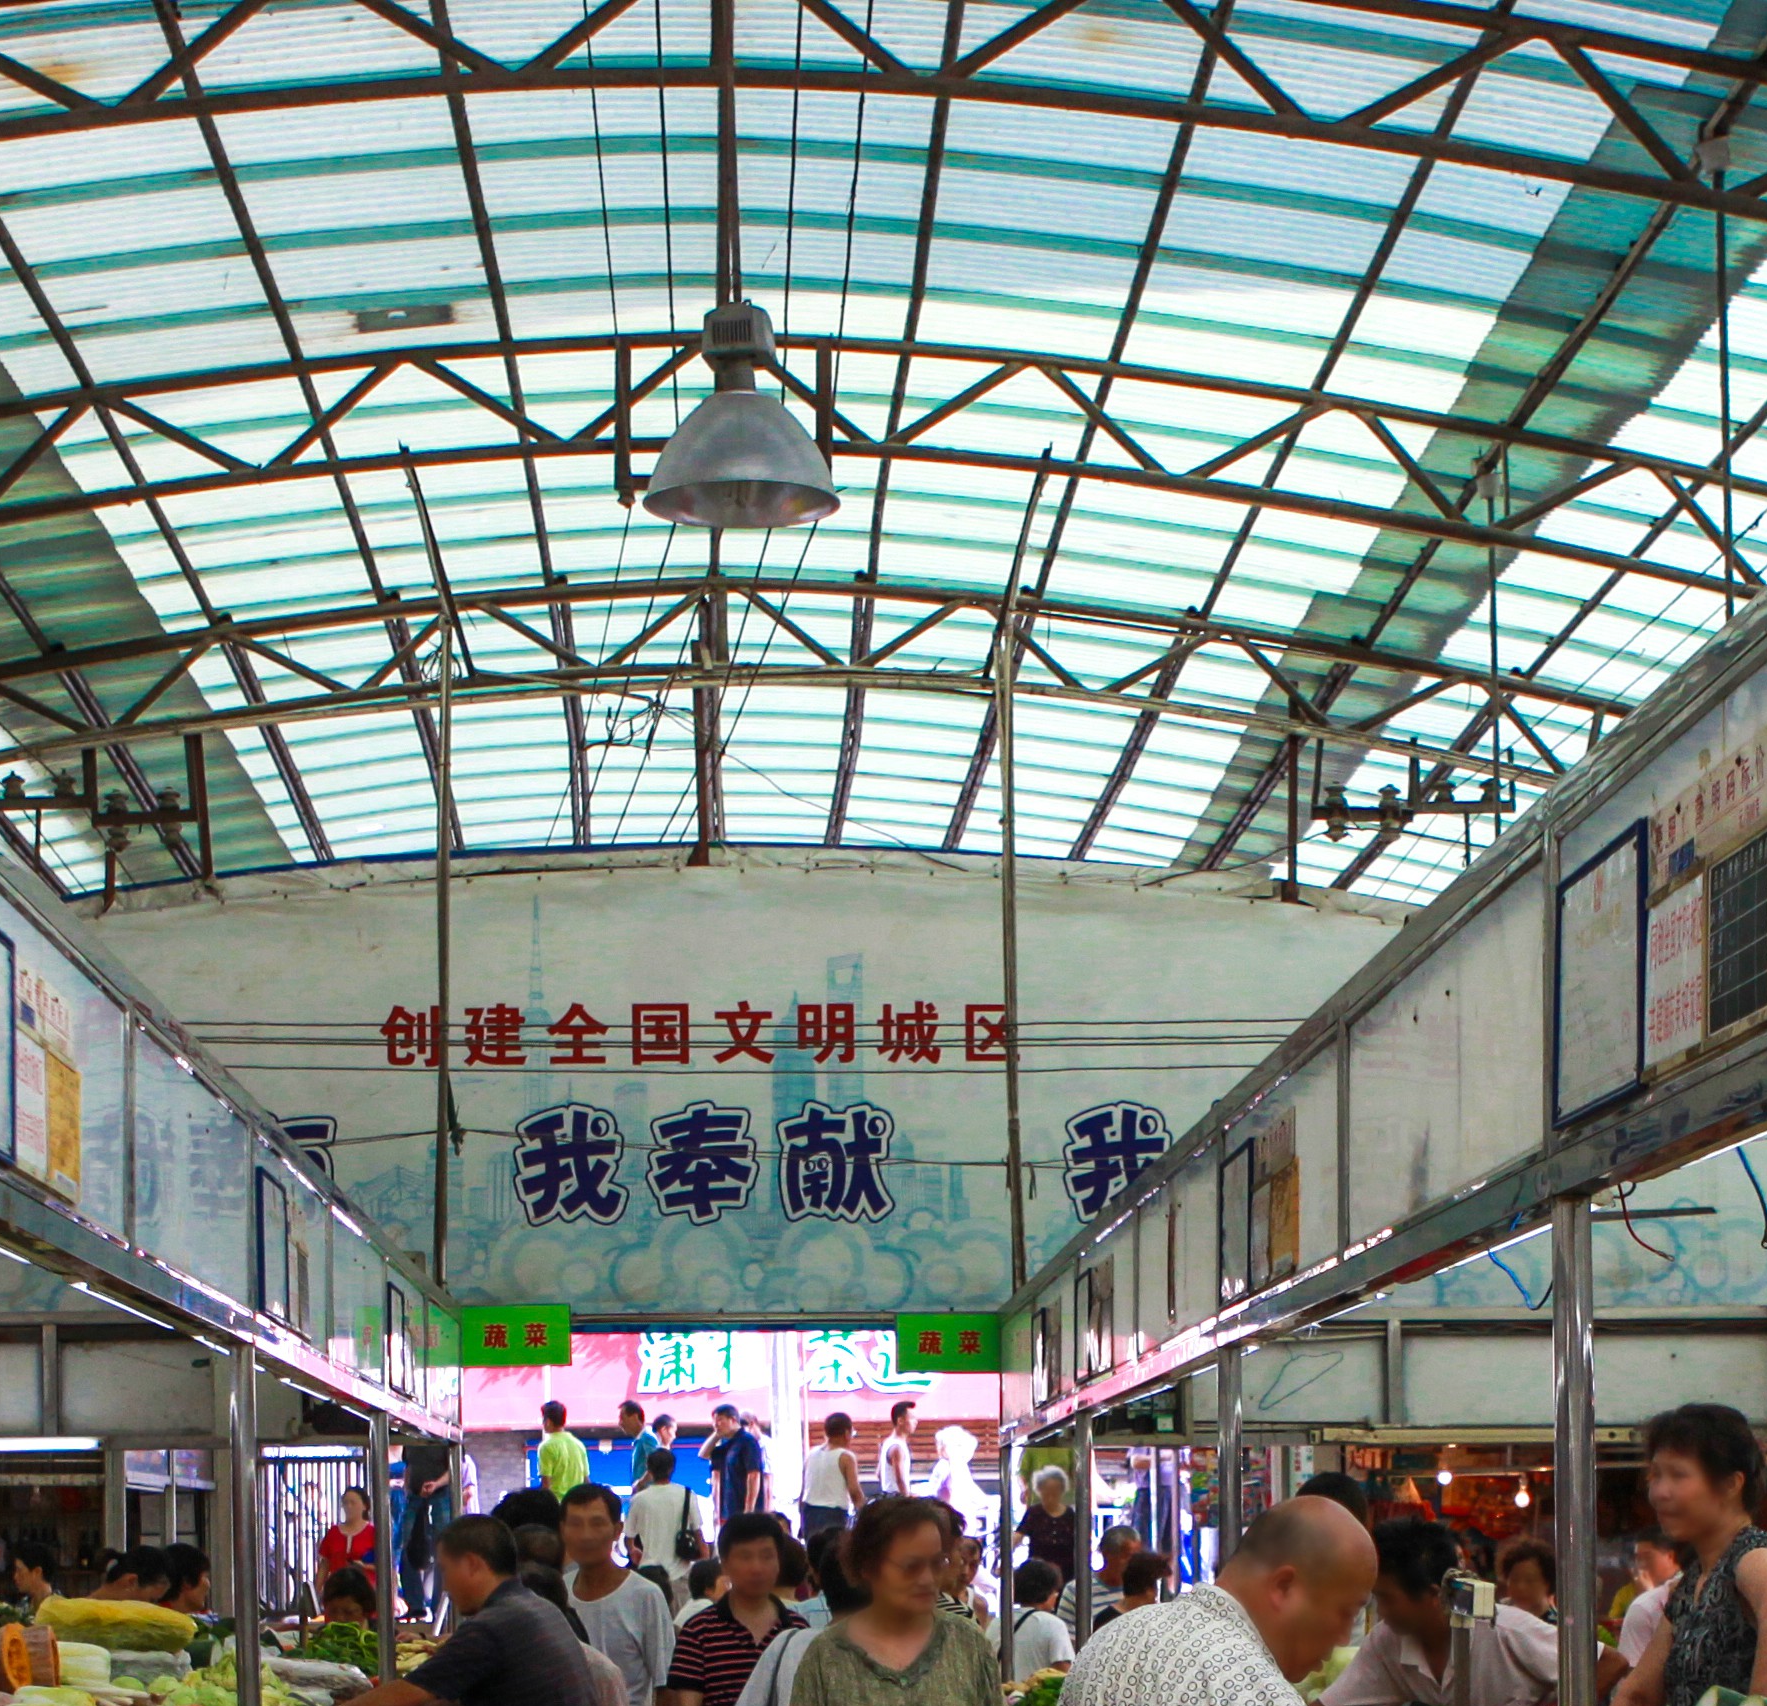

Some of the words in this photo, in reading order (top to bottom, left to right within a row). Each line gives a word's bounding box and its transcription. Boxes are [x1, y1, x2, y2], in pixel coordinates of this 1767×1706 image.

[380, 1003, 1020, 1067] 创建全国文明城区
[519, 1107, 894, 1223] 我奉献
[483, 1323, 548, 1349] 蔬菜
[918, 1331, 982, 1354] 蔬菜
